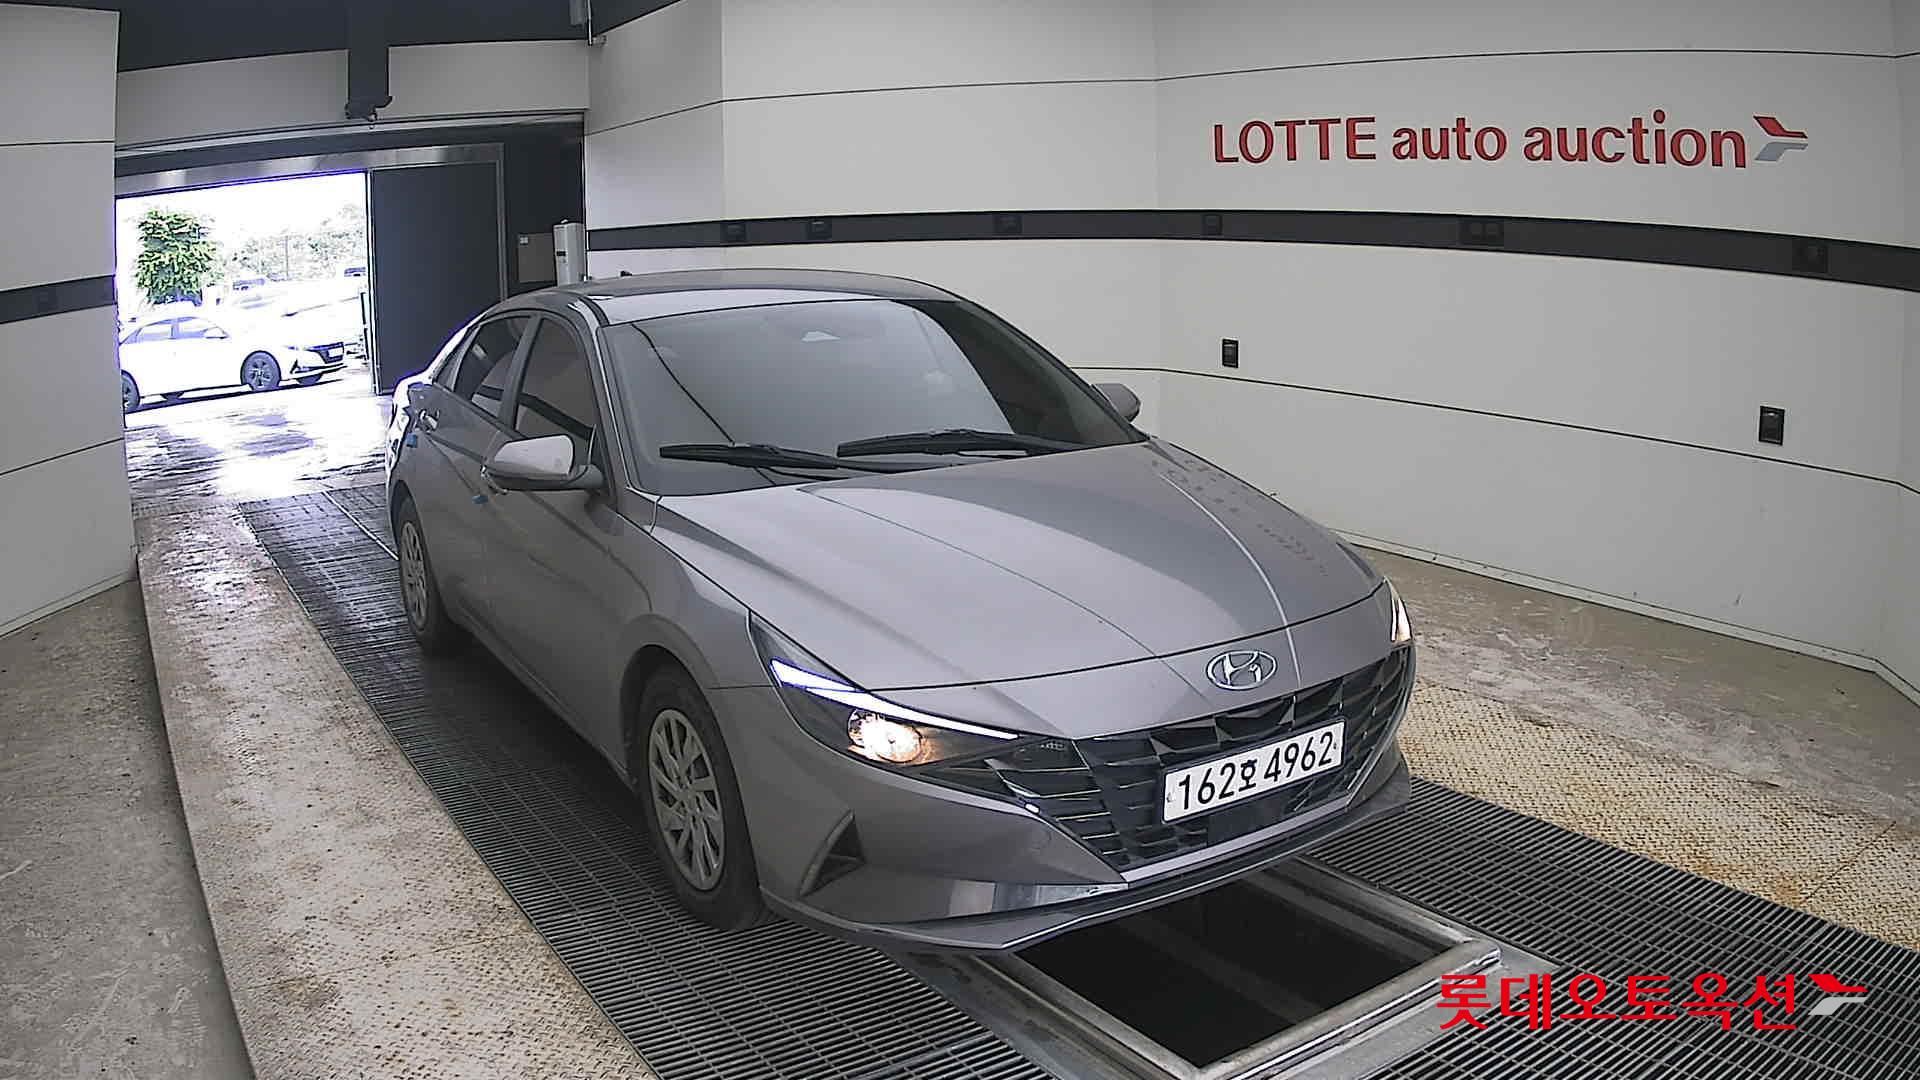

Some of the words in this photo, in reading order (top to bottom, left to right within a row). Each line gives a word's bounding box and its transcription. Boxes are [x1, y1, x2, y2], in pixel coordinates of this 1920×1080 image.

[1213, 116, 1377, 163] LOTTE
[1391, 117, 1508, 161] auto
[1522, 109, 1748, 168] auction
